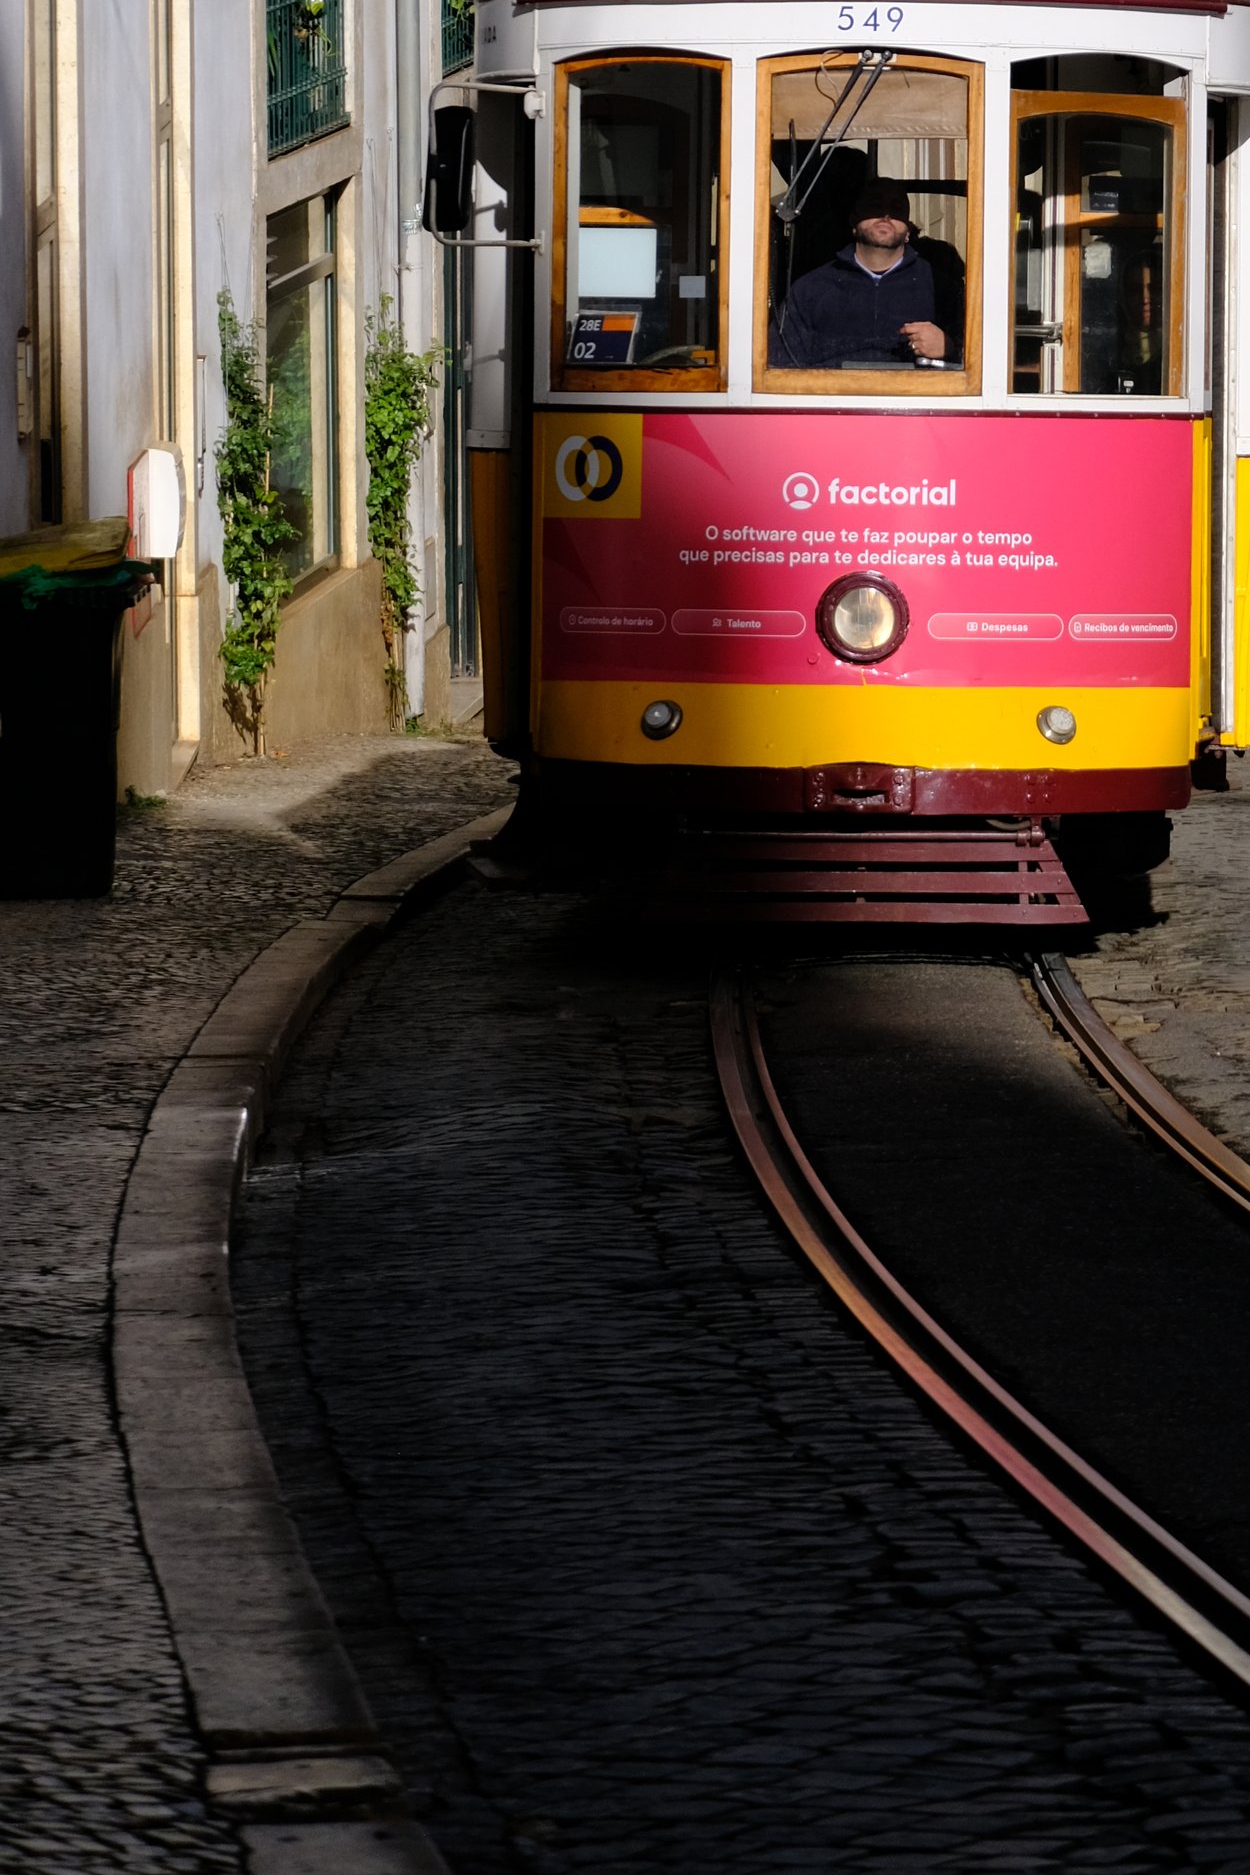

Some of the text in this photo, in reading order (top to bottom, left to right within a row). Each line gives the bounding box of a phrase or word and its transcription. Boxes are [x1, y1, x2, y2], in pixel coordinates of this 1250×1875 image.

[838, 6, 904, 32] 549
[579, 319, 602, 332] 28E
[574, 342, 597, 359] 02
[828, 478, 957, 506] factorial
[705, 526, 1033, 548] O software que te faz poupar o tempo
[679, 548, 1058, 570] que precisas para te dedicares à tua equipa.
[611, 616, 622, 626] de
[727, 618, 762, 629] Talento
[981, 622, 1029, 633] Despesas
[1084, 622, 1175, 633] Recibos de vencimento
